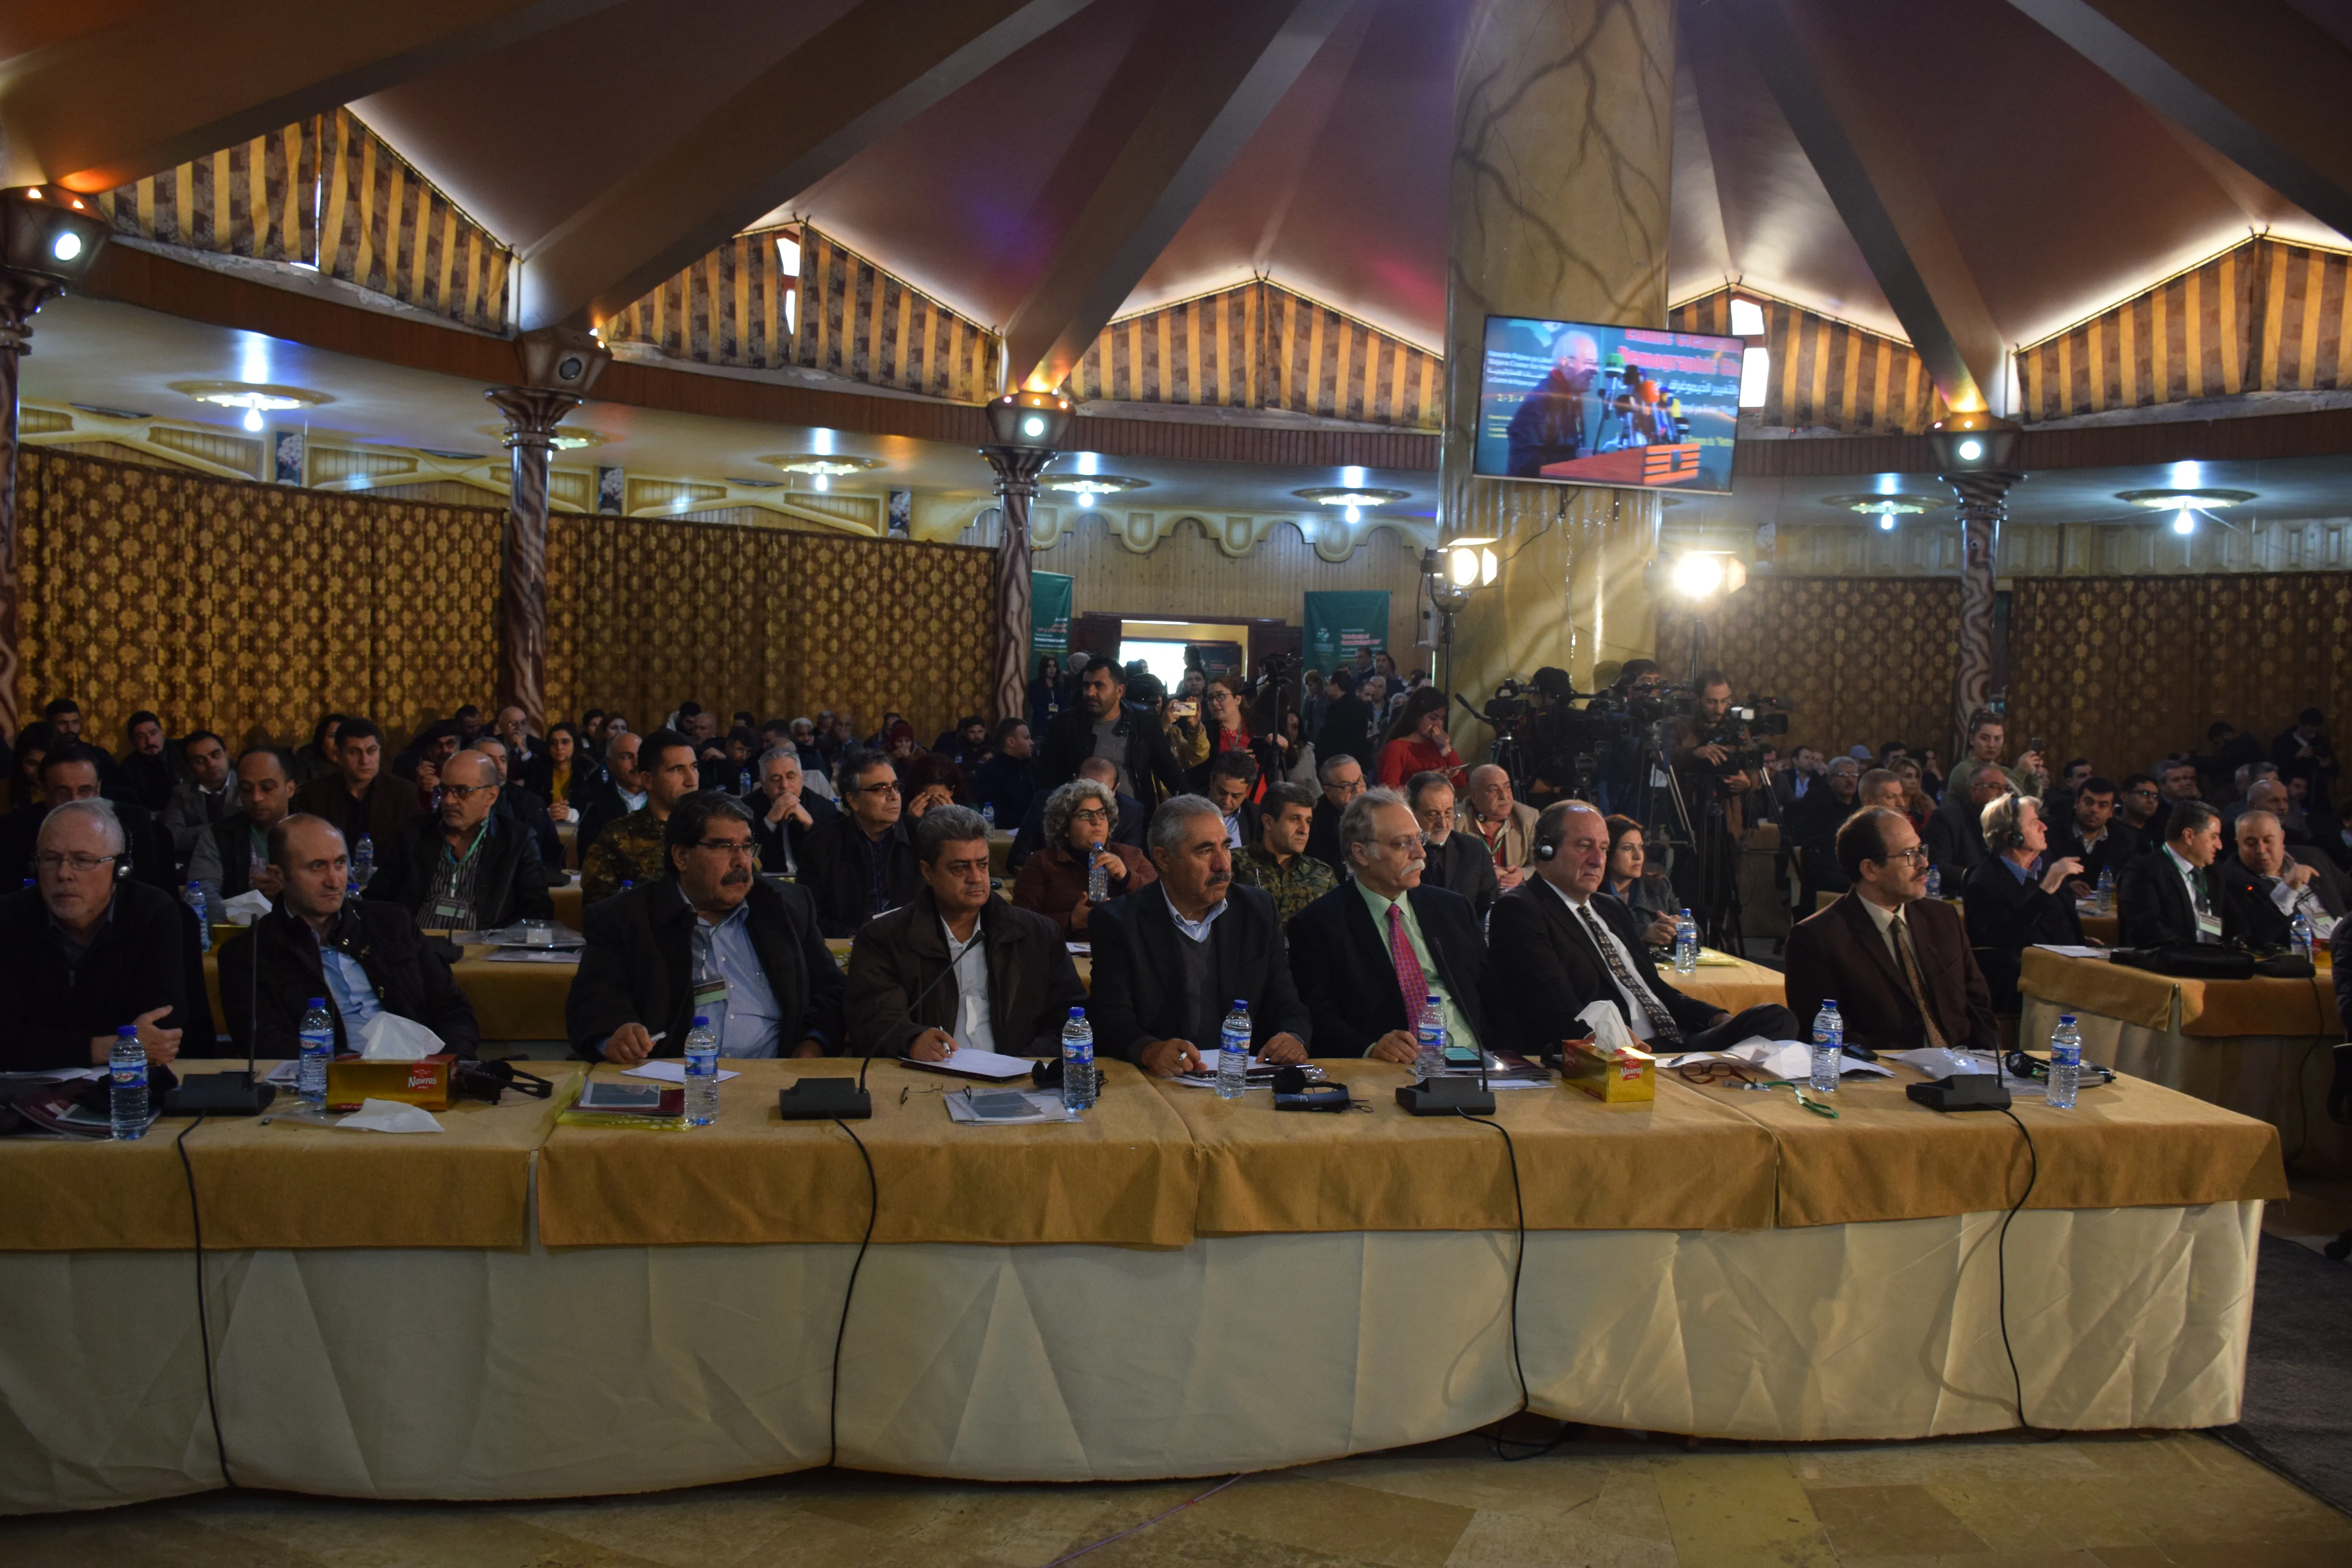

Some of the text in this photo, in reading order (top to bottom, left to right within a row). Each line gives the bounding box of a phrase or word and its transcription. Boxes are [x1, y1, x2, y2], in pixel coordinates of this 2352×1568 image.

[1617, 346, 1717, 375] Demographic
[1620, 1067, 1643, 1077] Nawras
[408, 1076, 437, 1087] Nawras
